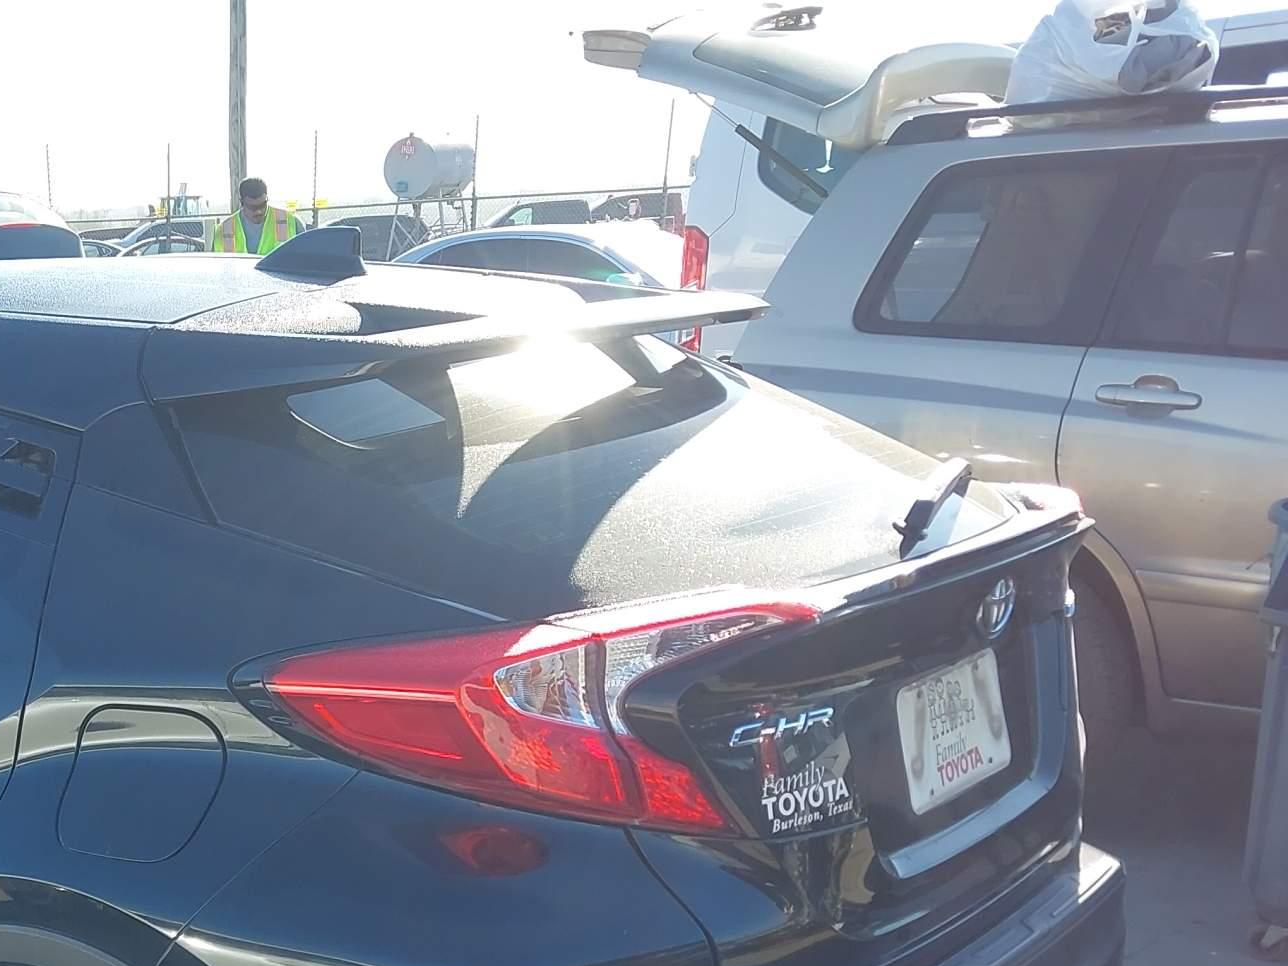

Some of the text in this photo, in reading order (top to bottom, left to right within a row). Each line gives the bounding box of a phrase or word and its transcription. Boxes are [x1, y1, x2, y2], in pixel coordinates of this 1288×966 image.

[729, 707, 835, 748] C-HR
[935, 732, 968, 765] Family
[937, 746, 984, 787] TOYOTA
[762, 761, 825, 798] Family
[762, 777, 850, 820] TOYOTA
[772, 799, 854, 833] Burleson, Texas
